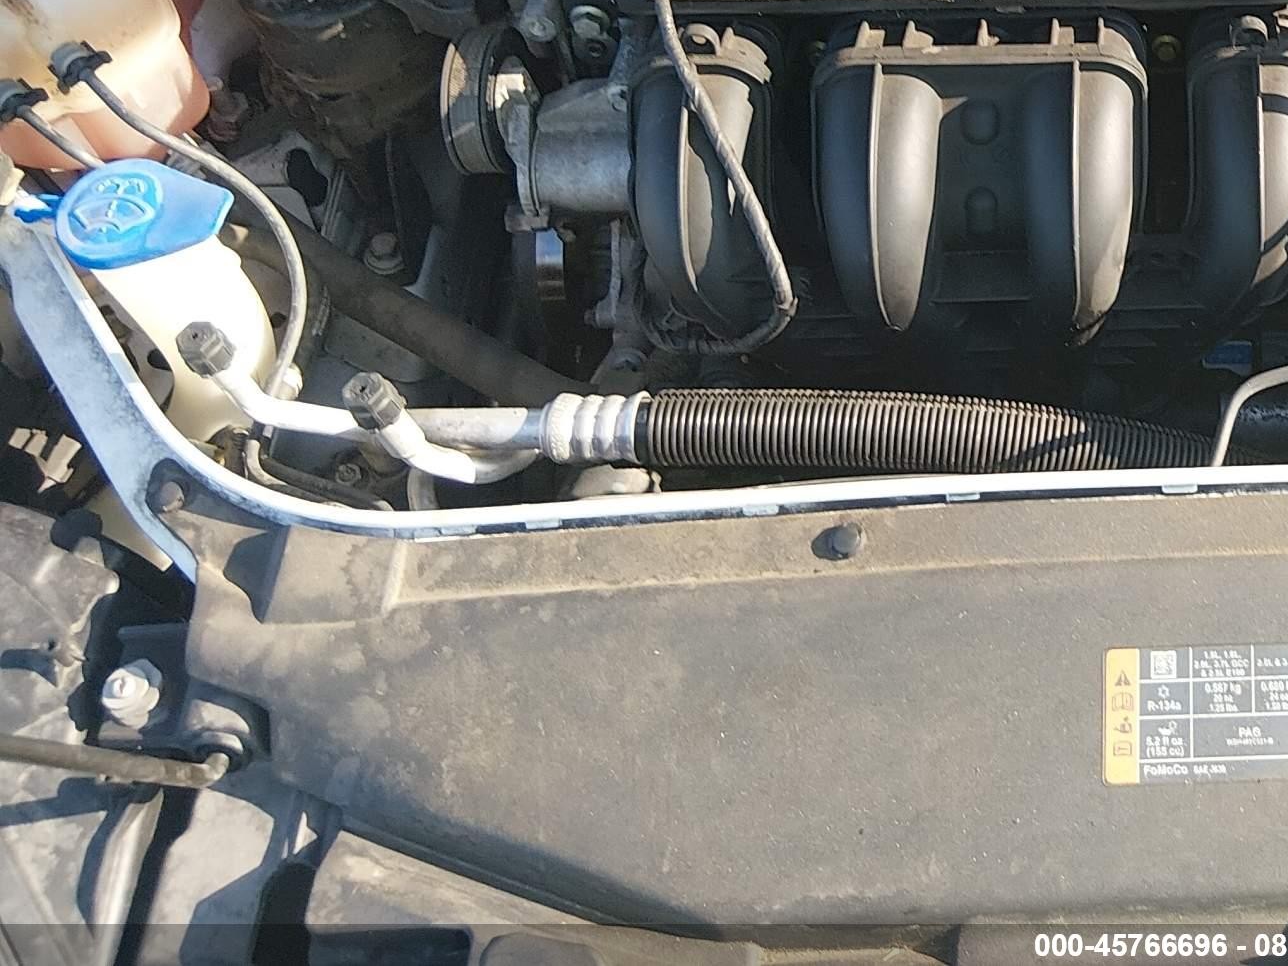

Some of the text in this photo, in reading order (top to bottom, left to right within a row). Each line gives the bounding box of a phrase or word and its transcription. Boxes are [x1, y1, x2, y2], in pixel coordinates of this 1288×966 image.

[1147, 700, 1182, 712] R-134a
[1237, 726, 1262, 738] PAG
[1170, 736, 1184, 746] oz
[1143, 764, 1189, 776] FoMoCo
